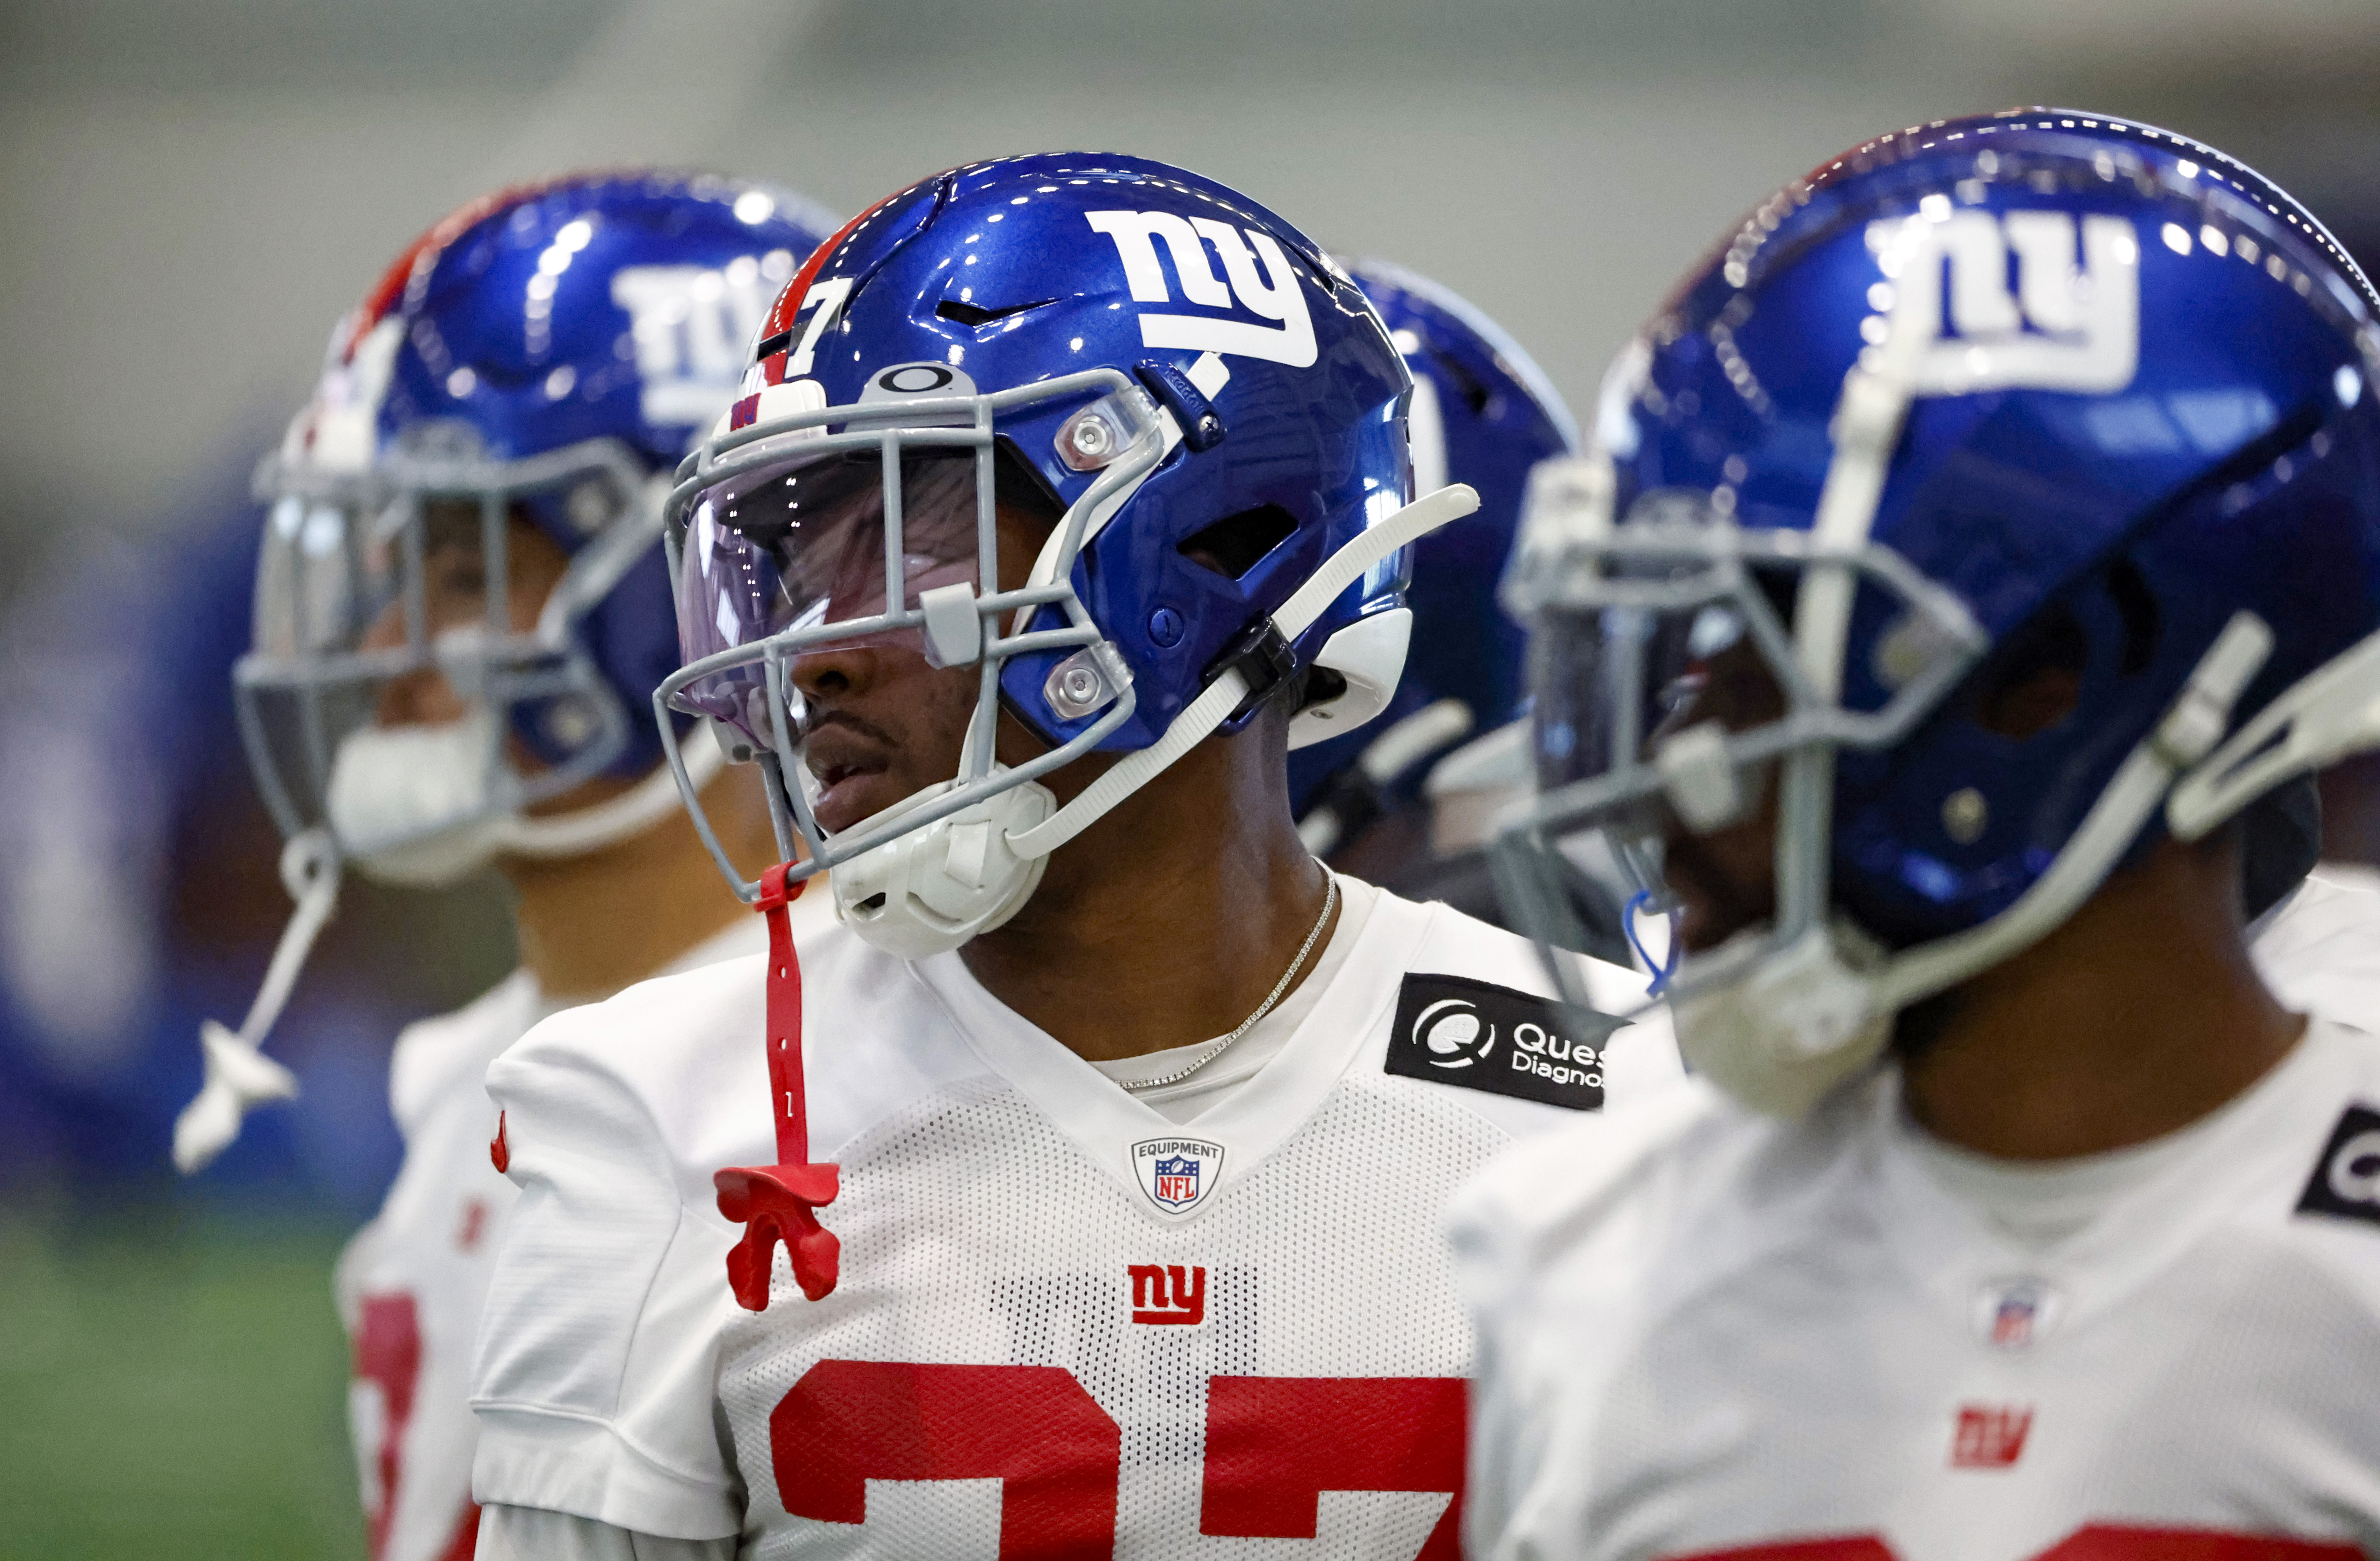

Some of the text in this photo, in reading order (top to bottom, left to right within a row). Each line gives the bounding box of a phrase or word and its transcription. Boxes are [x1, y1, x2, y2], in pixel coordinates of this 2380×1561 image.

[1084, 210, 1318, 368] ny
[785, 278, 854, 379] 7
[1511, 1050, 1605, 1088] Diagno
[1139, 1142, 1218, 1159] EQUIPMENT
[1159, 1177, 1194, 1201] NFL
[1128, 1264, 1206, 1325] ny
